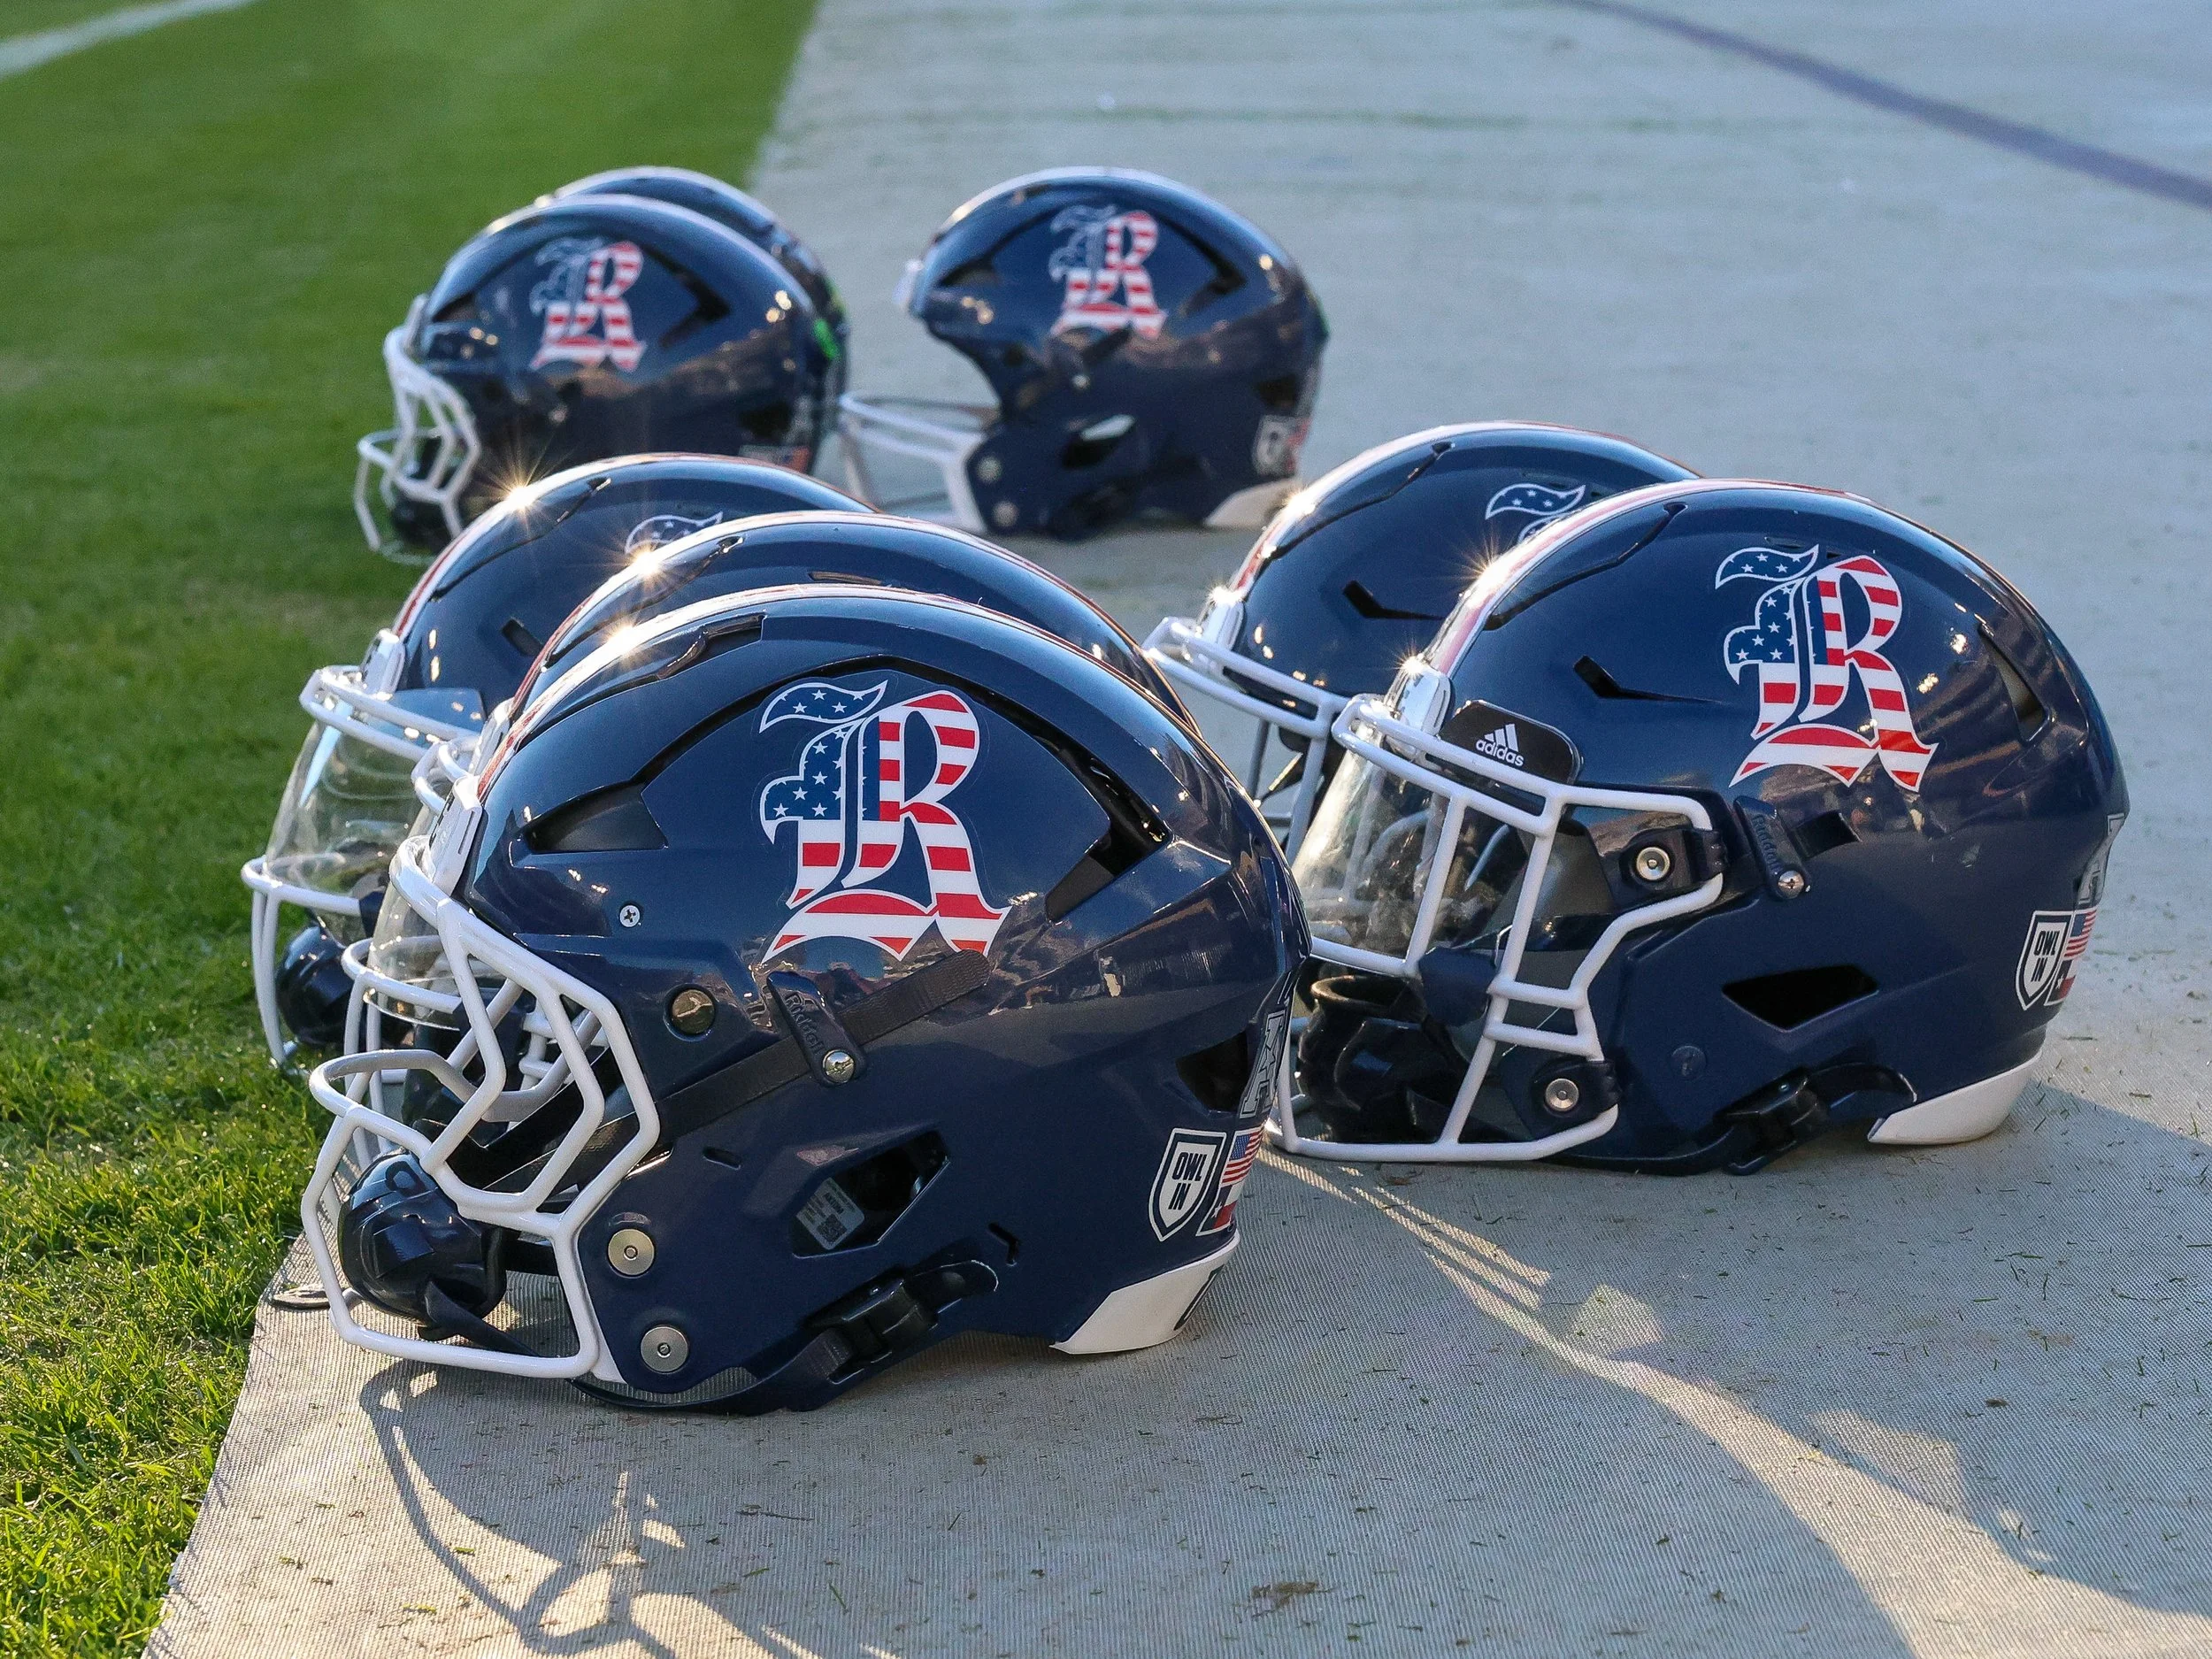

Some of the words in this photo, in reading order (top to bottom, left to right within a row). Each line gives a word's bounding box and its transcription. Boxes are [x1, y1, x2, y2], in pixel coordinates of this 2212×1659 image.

[1048, 204, 1168, 340] R
[528, 235, 648, 373] R
[1715, 542, 1939, 792] R
[1475, 738, 1525, 767] adidas
[759, 680, 1012, 964] R
[2033, 930, 2060, 956] OWL
[2031, 957, 2048, 982] IN
[1171, 1152, 1208, 1181] OWL
[1168, 1182, 1192, 1210] IN
